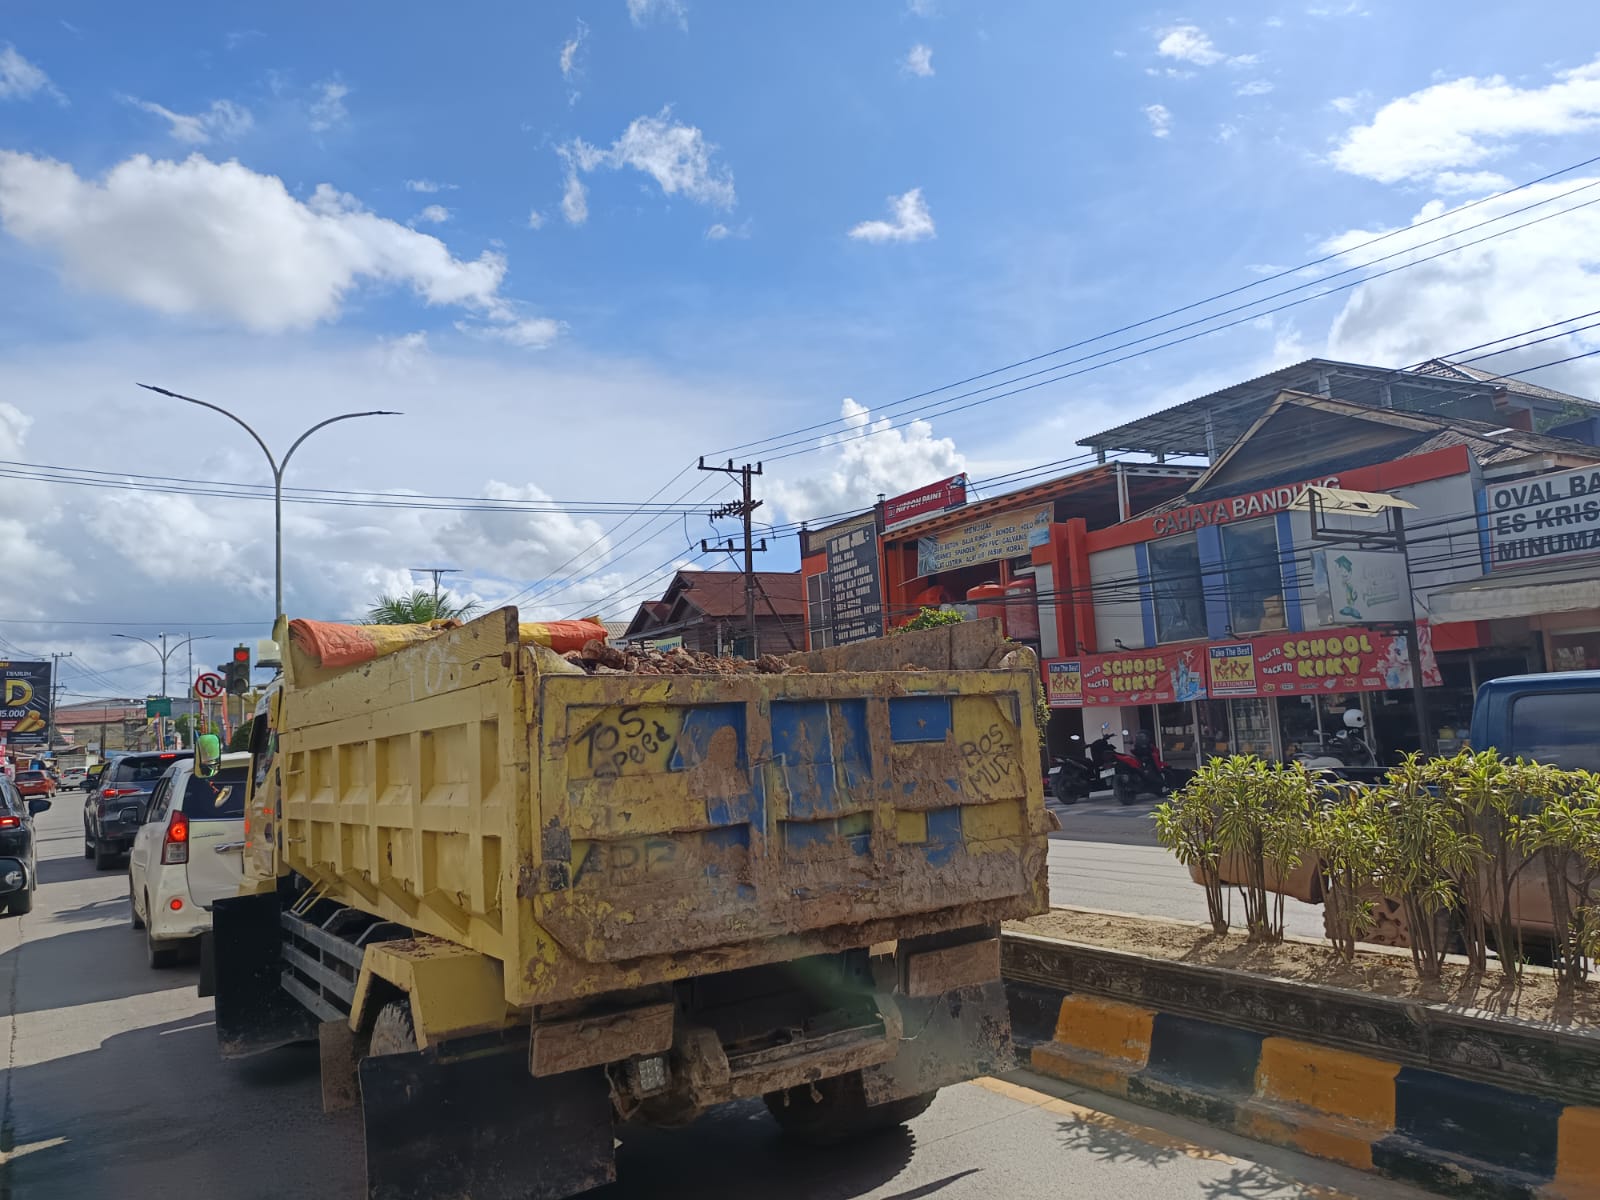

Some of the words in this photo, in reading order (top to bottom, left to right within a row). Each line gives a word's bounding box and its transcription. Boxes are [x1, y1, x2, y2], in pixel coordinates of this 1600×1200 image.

[921, 491, 942, 504] PAINT
[1494, 481, 1560, 509] OVAL
[1569, 472, 1600, 497] BA
[1152, 501, 1230, 535] CAHAYA
[1232, 477, 1340, 518] BANDG
[1496, 513, 1527, 535] ES
[1226, 647, 1236, 656] The
[1272, 648, 1281, 656] TO
[1283, 635, 1373, 660] SCHOOL
[1102, 657, 1166, 676] SCHOOL
[1263, 664, 1282, 674] BACK
[1282, 662, 1293, 673] TO
[1297, 656, 1361, 678] KIKY
[1112, 674, 1157, 692] KIKY
